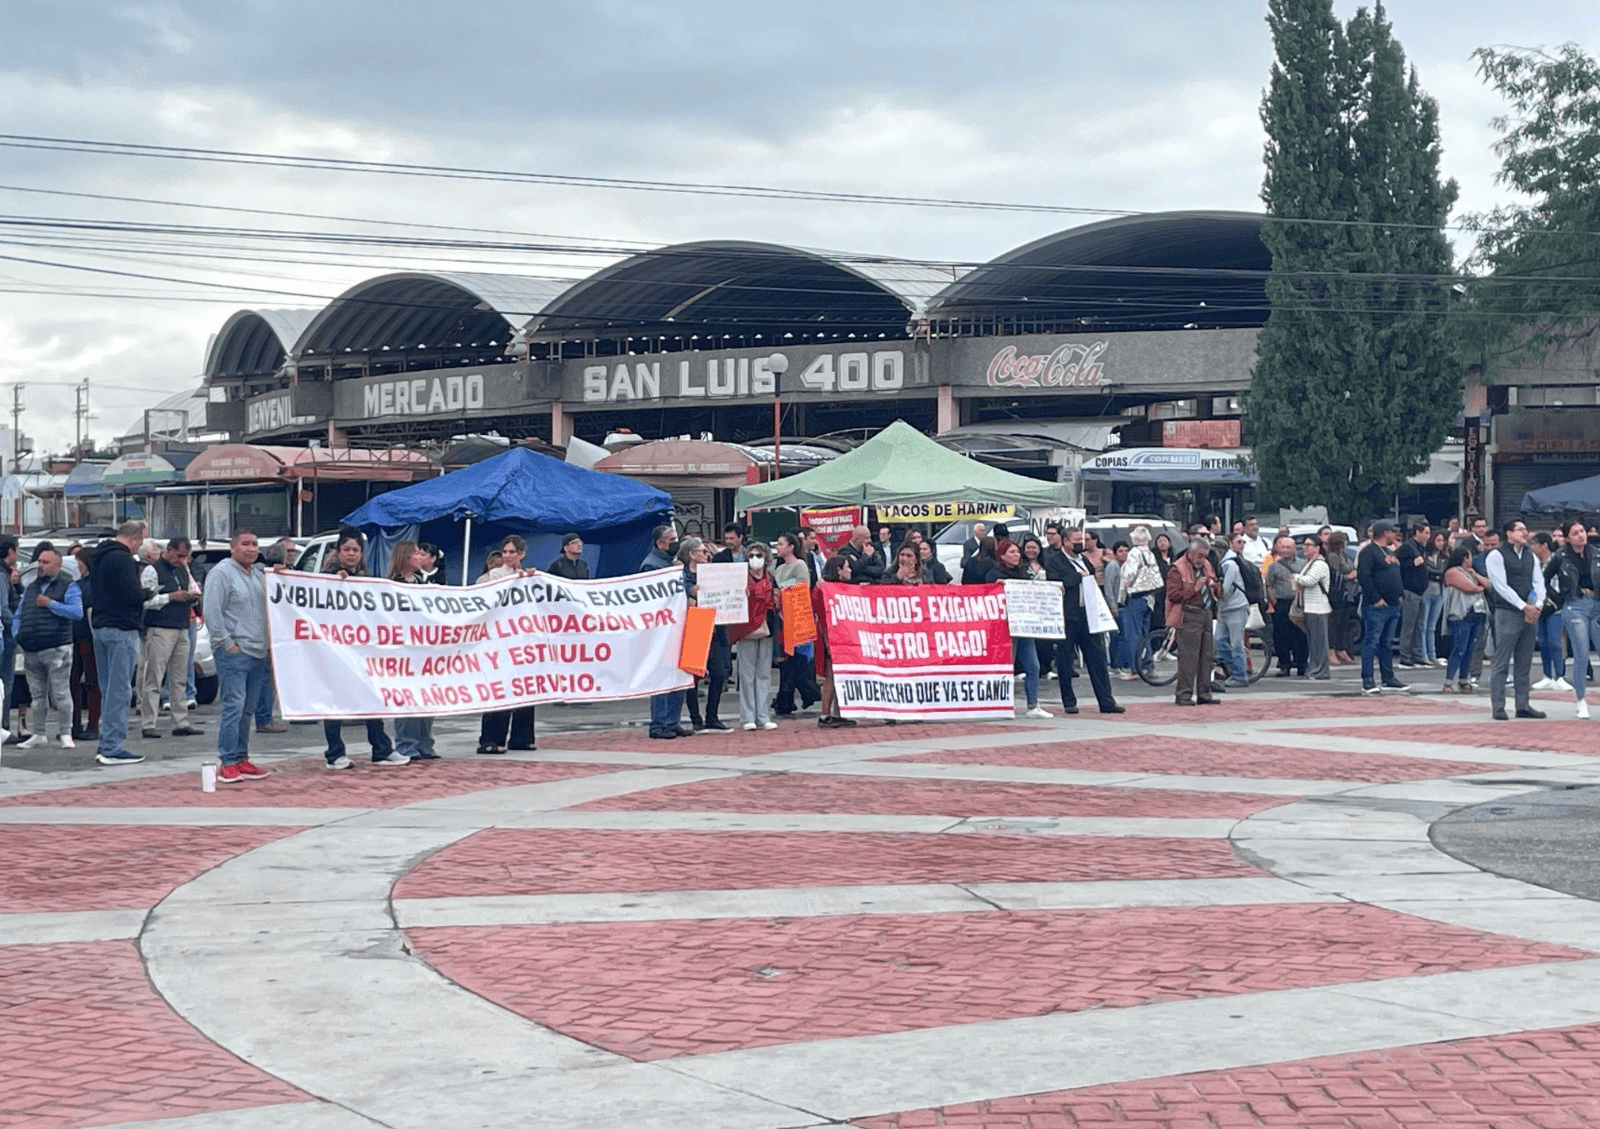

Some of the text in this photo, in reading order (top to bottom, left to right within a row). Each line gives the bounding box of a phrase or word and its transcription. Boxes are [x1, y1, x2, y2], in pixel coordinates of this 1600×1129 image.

[583, 350, 904, 401] SAN LUIS 400
[987, 340, 1108, 386] Coca-Cola
[364, 374, 484, 418] MERCADO
[1095, 457, 1128, 467] COPIAS
[1201, 458, 1241, 469] INTERNE
[884, 502, 1008, 517] TACOS DE HARINA
[270, 583, 377, 612] JUBILADOS
[381, 592, 422, 612] DEL
[423, 596, 491, 613] PODER
[829, 593, 923, 626] ¡JUBILADOS
[928, 593, 1007, 623] EXIGIMOS
[295, 619, 321, 640] EL
[320, 624, 370, 646] PAGO
[377, 624, 404, 646] DE
[410, 622, 490, 646] NUESTRA
[858, 629, 988, 660] NUESTRO PAGO!
[485, 650, 499, 670] Y
[381, 687, 419, 707] POR
[421, 683, 473, 706] AÑOS
[476, 680, 506, 701] DE
[842, 675, 1010, 706] ¡UN DERECHO QUE YA SE GANÓ!
